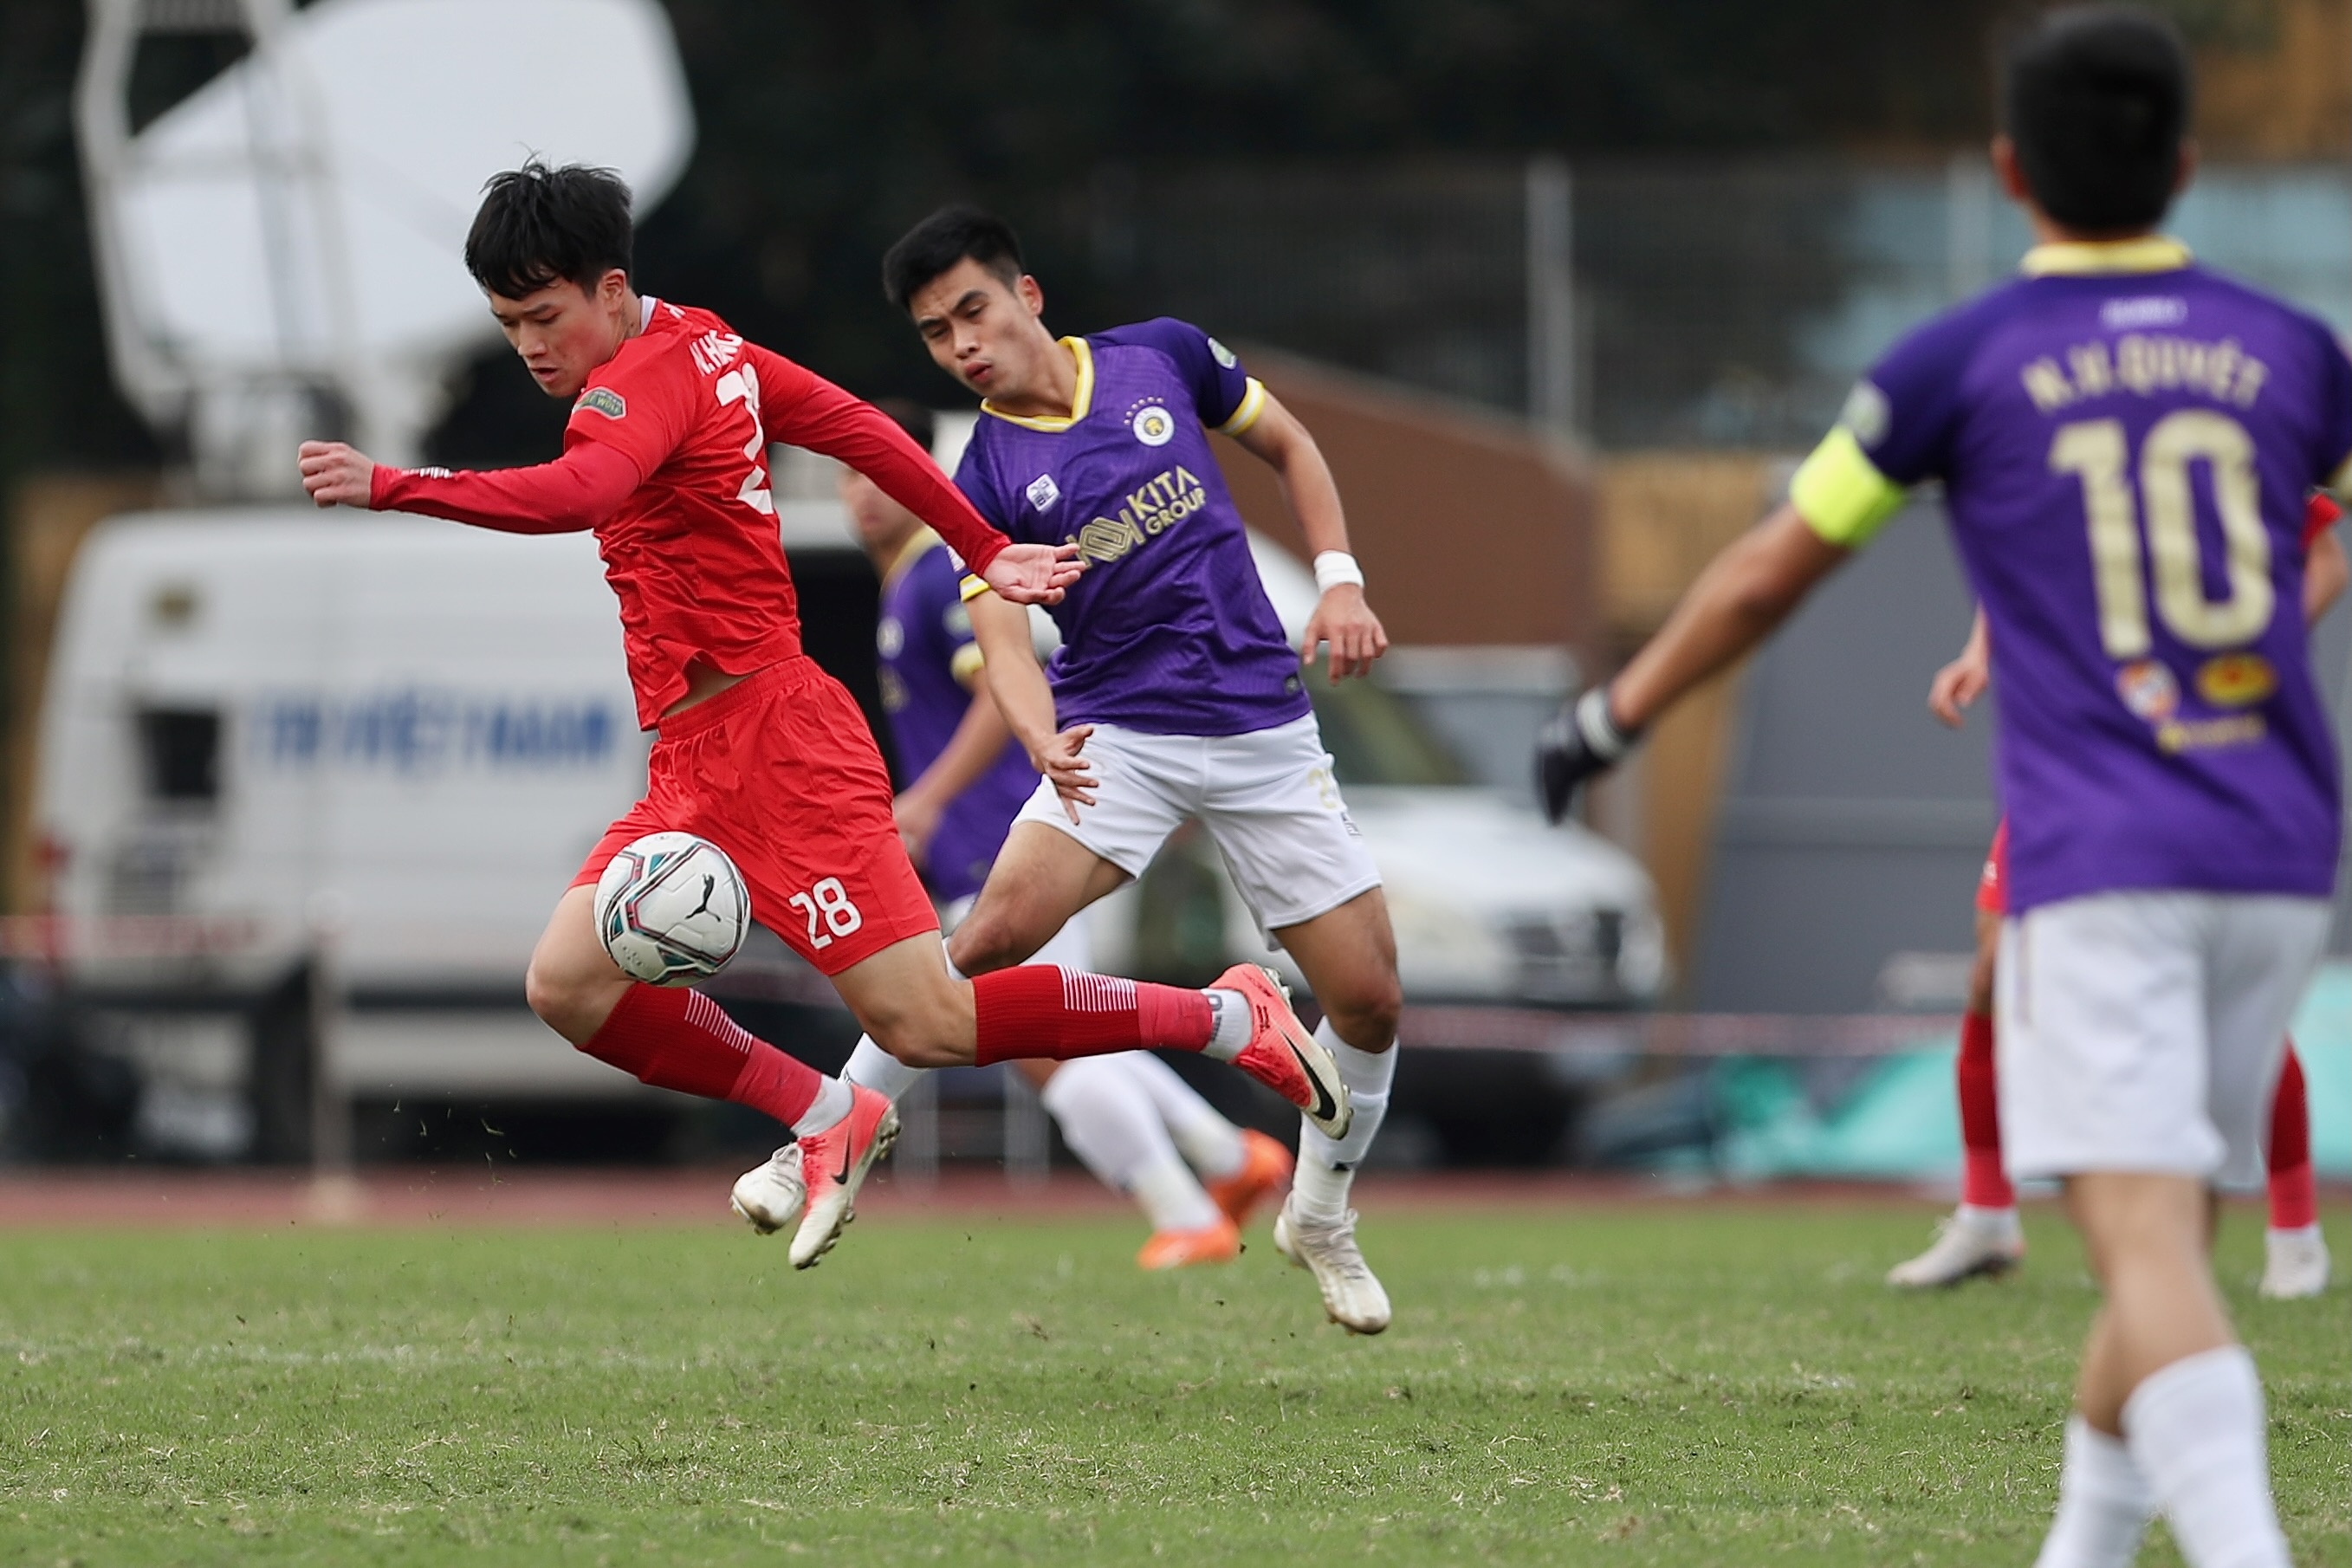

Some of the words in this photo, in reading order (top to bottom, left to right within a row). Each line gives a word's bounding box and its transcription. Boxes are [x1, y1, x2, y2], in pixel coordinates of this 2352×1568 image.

[1126, 464, 1201, 521] KITA
[1144, 487, 1206, 535] GROUP
[2049, 409, 2276, 659] 10
[788, 876, 863, 950] 28
